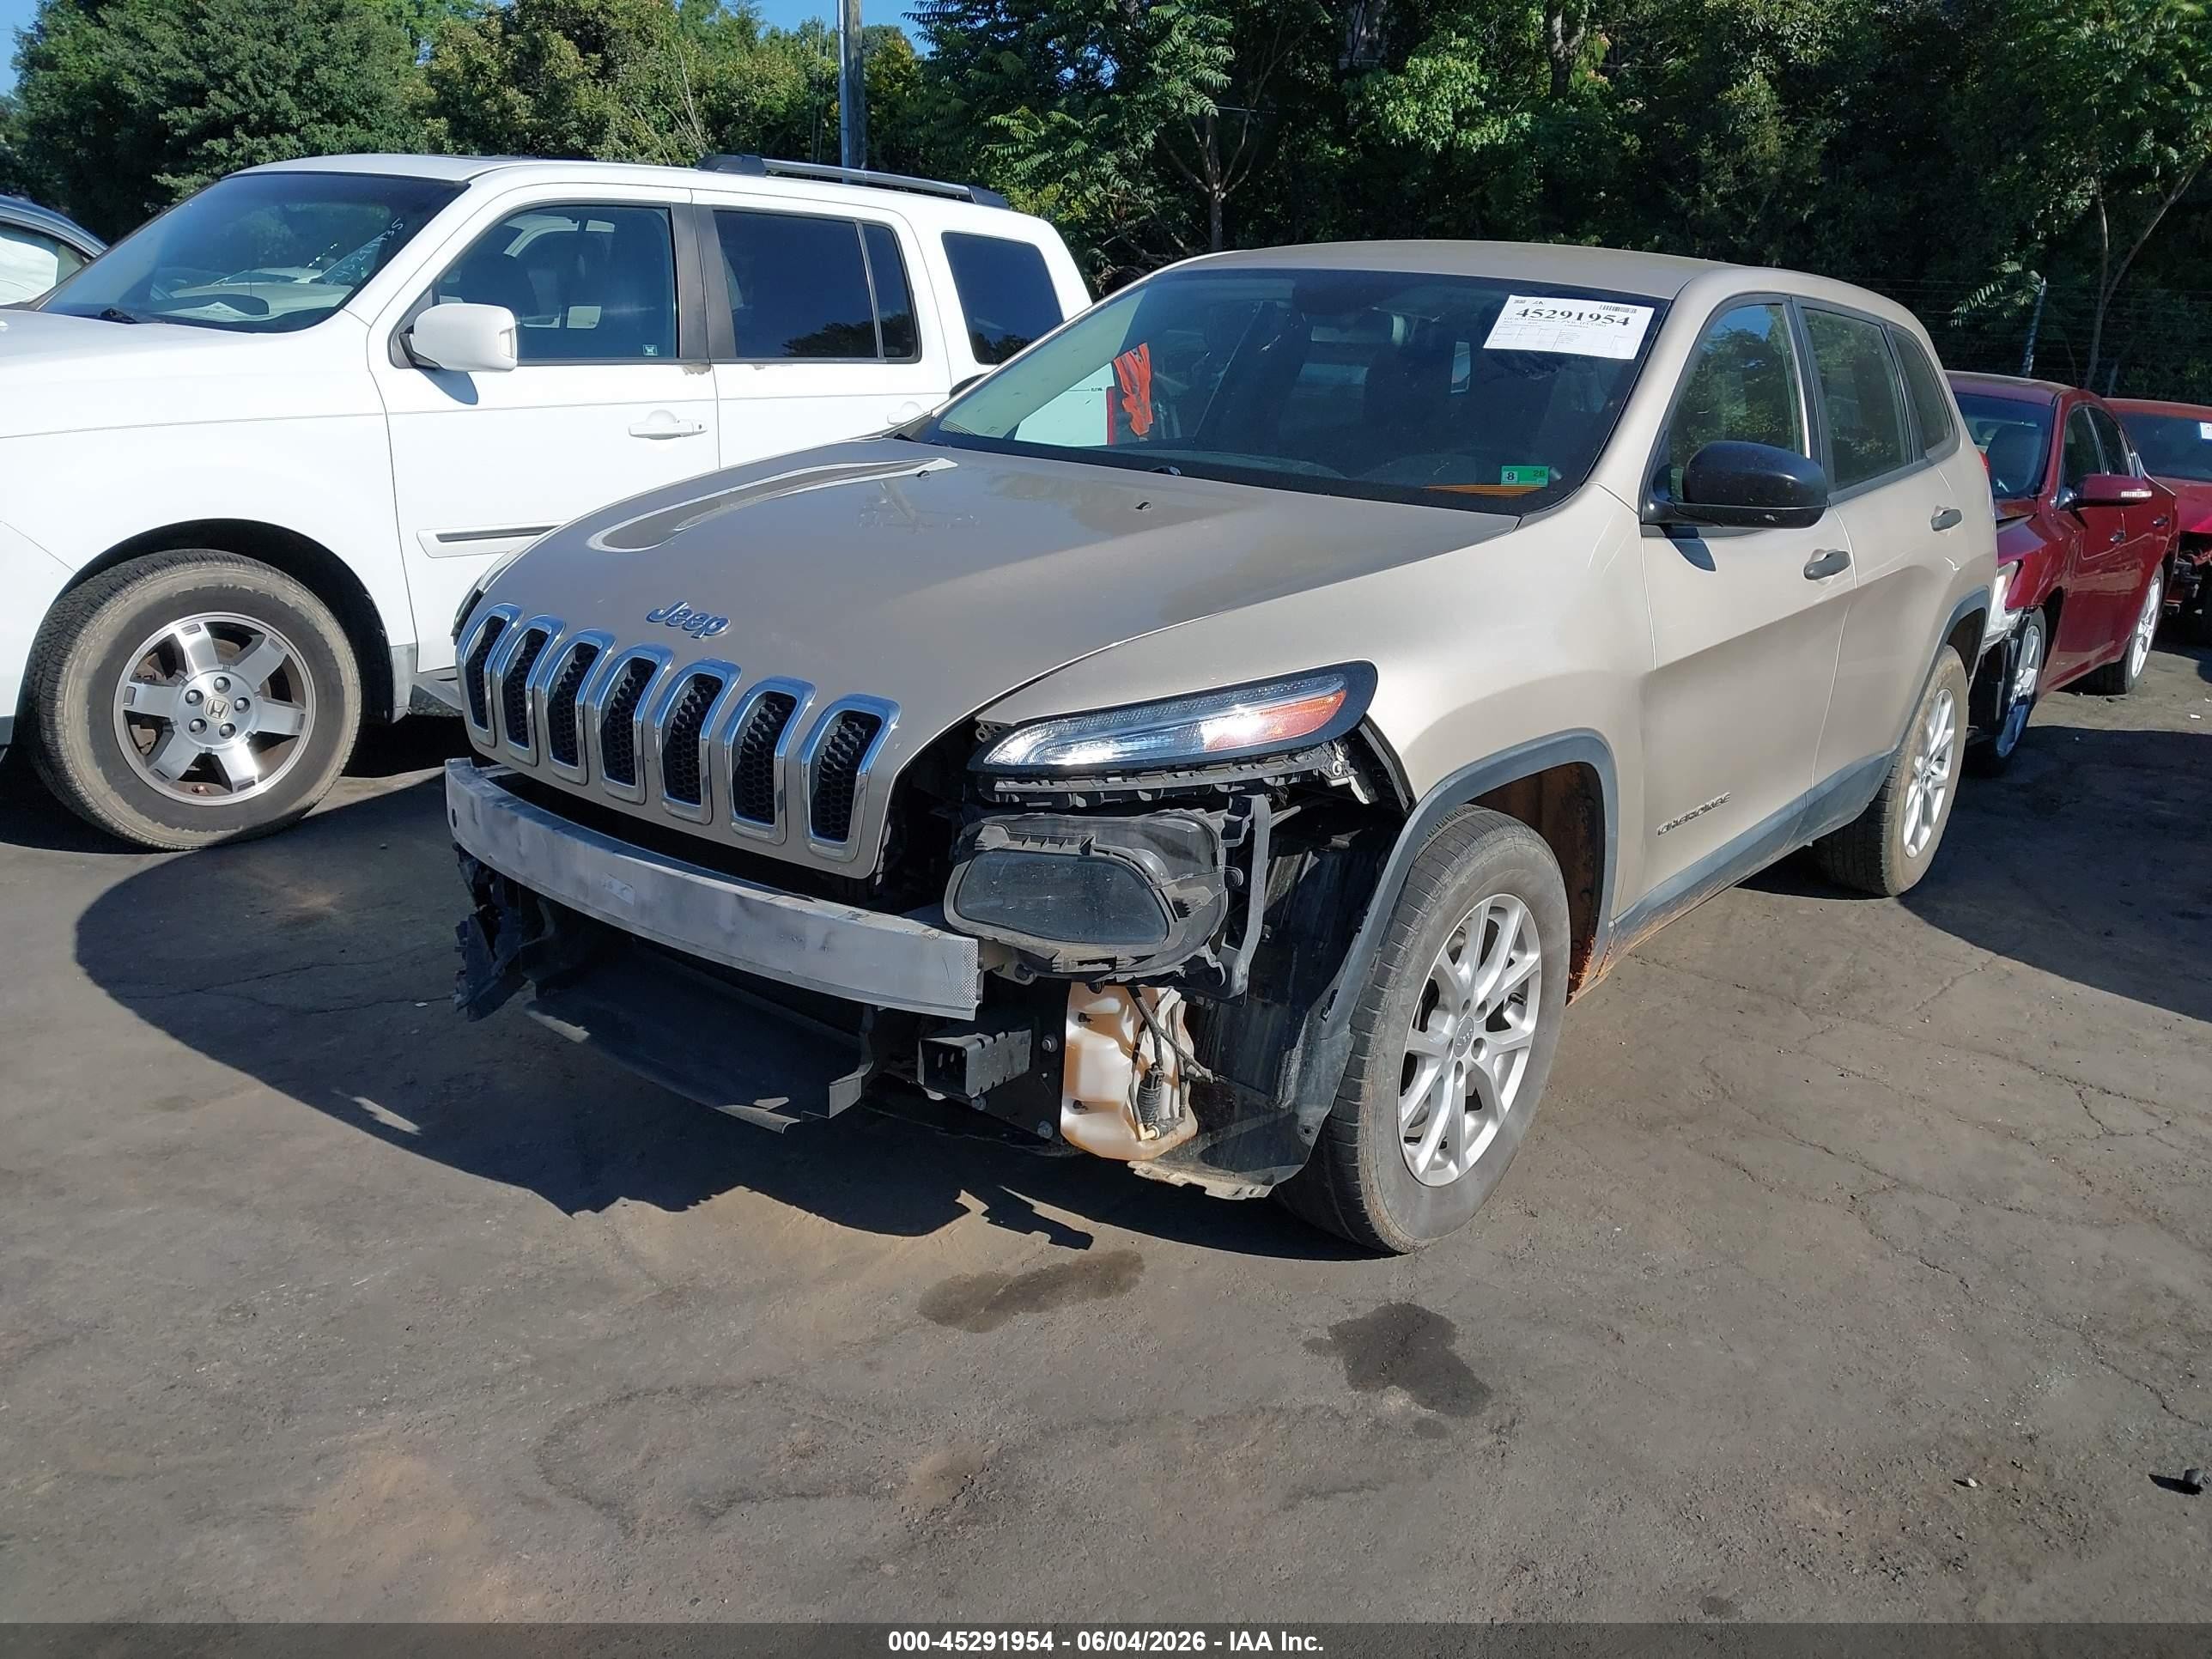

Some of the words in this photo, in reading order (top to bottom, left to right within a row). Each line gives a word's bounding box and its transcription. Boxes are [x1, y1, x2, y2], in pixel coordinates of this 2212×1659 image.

[1516, 308, 1630, 326] 45291954
[1507, 471, 1515, 481] 8
[646, 600, 731, 639] Jeep
